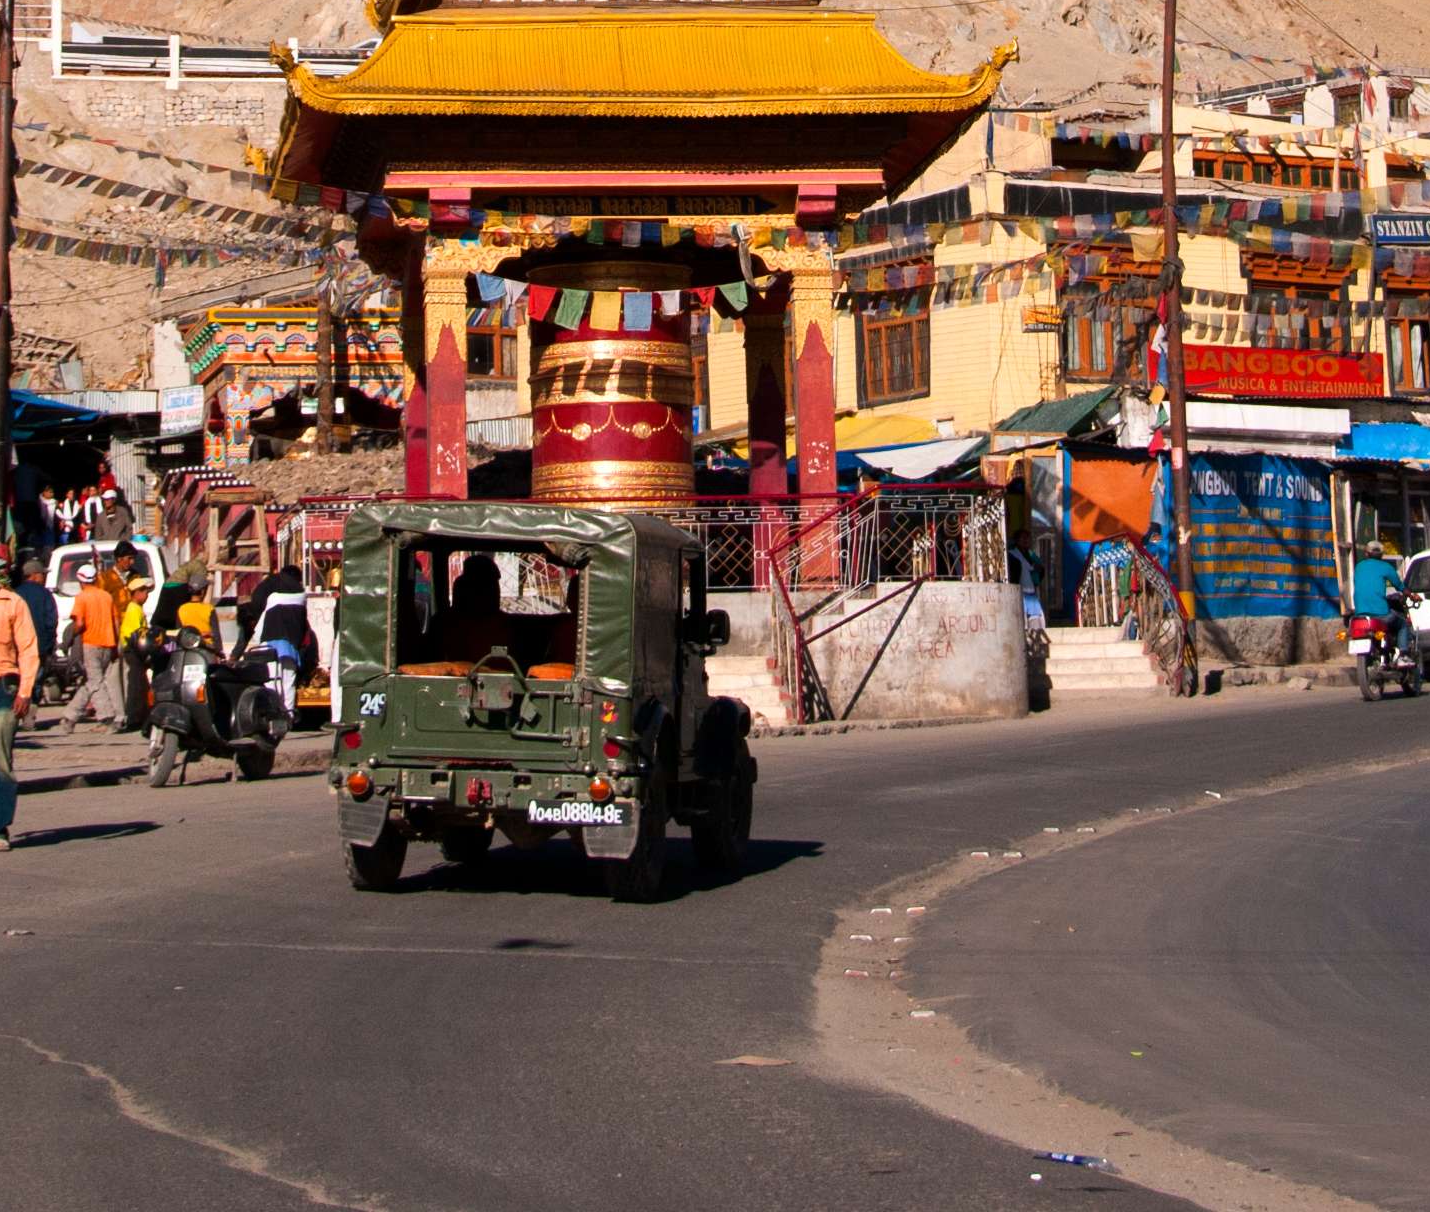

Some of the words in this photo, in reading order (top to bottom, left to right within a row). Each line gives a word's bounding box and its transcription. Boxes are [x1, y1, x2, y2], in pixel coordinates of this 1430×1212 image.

[1376, 220, 1423, 237] STANZIN
[1183, 350, 1339, 378] BANGBOO
[1218, 376, 1265, 392] MUSICA
[1270, 380, 1277, 392] &
[1282, 379, 1382, 397] ENTERTAINMENT
[1244, 471, 1274, 497] TENT
[1276, 474, 1284, 498] &
[1285, 474, 1323, 502] SOUND
